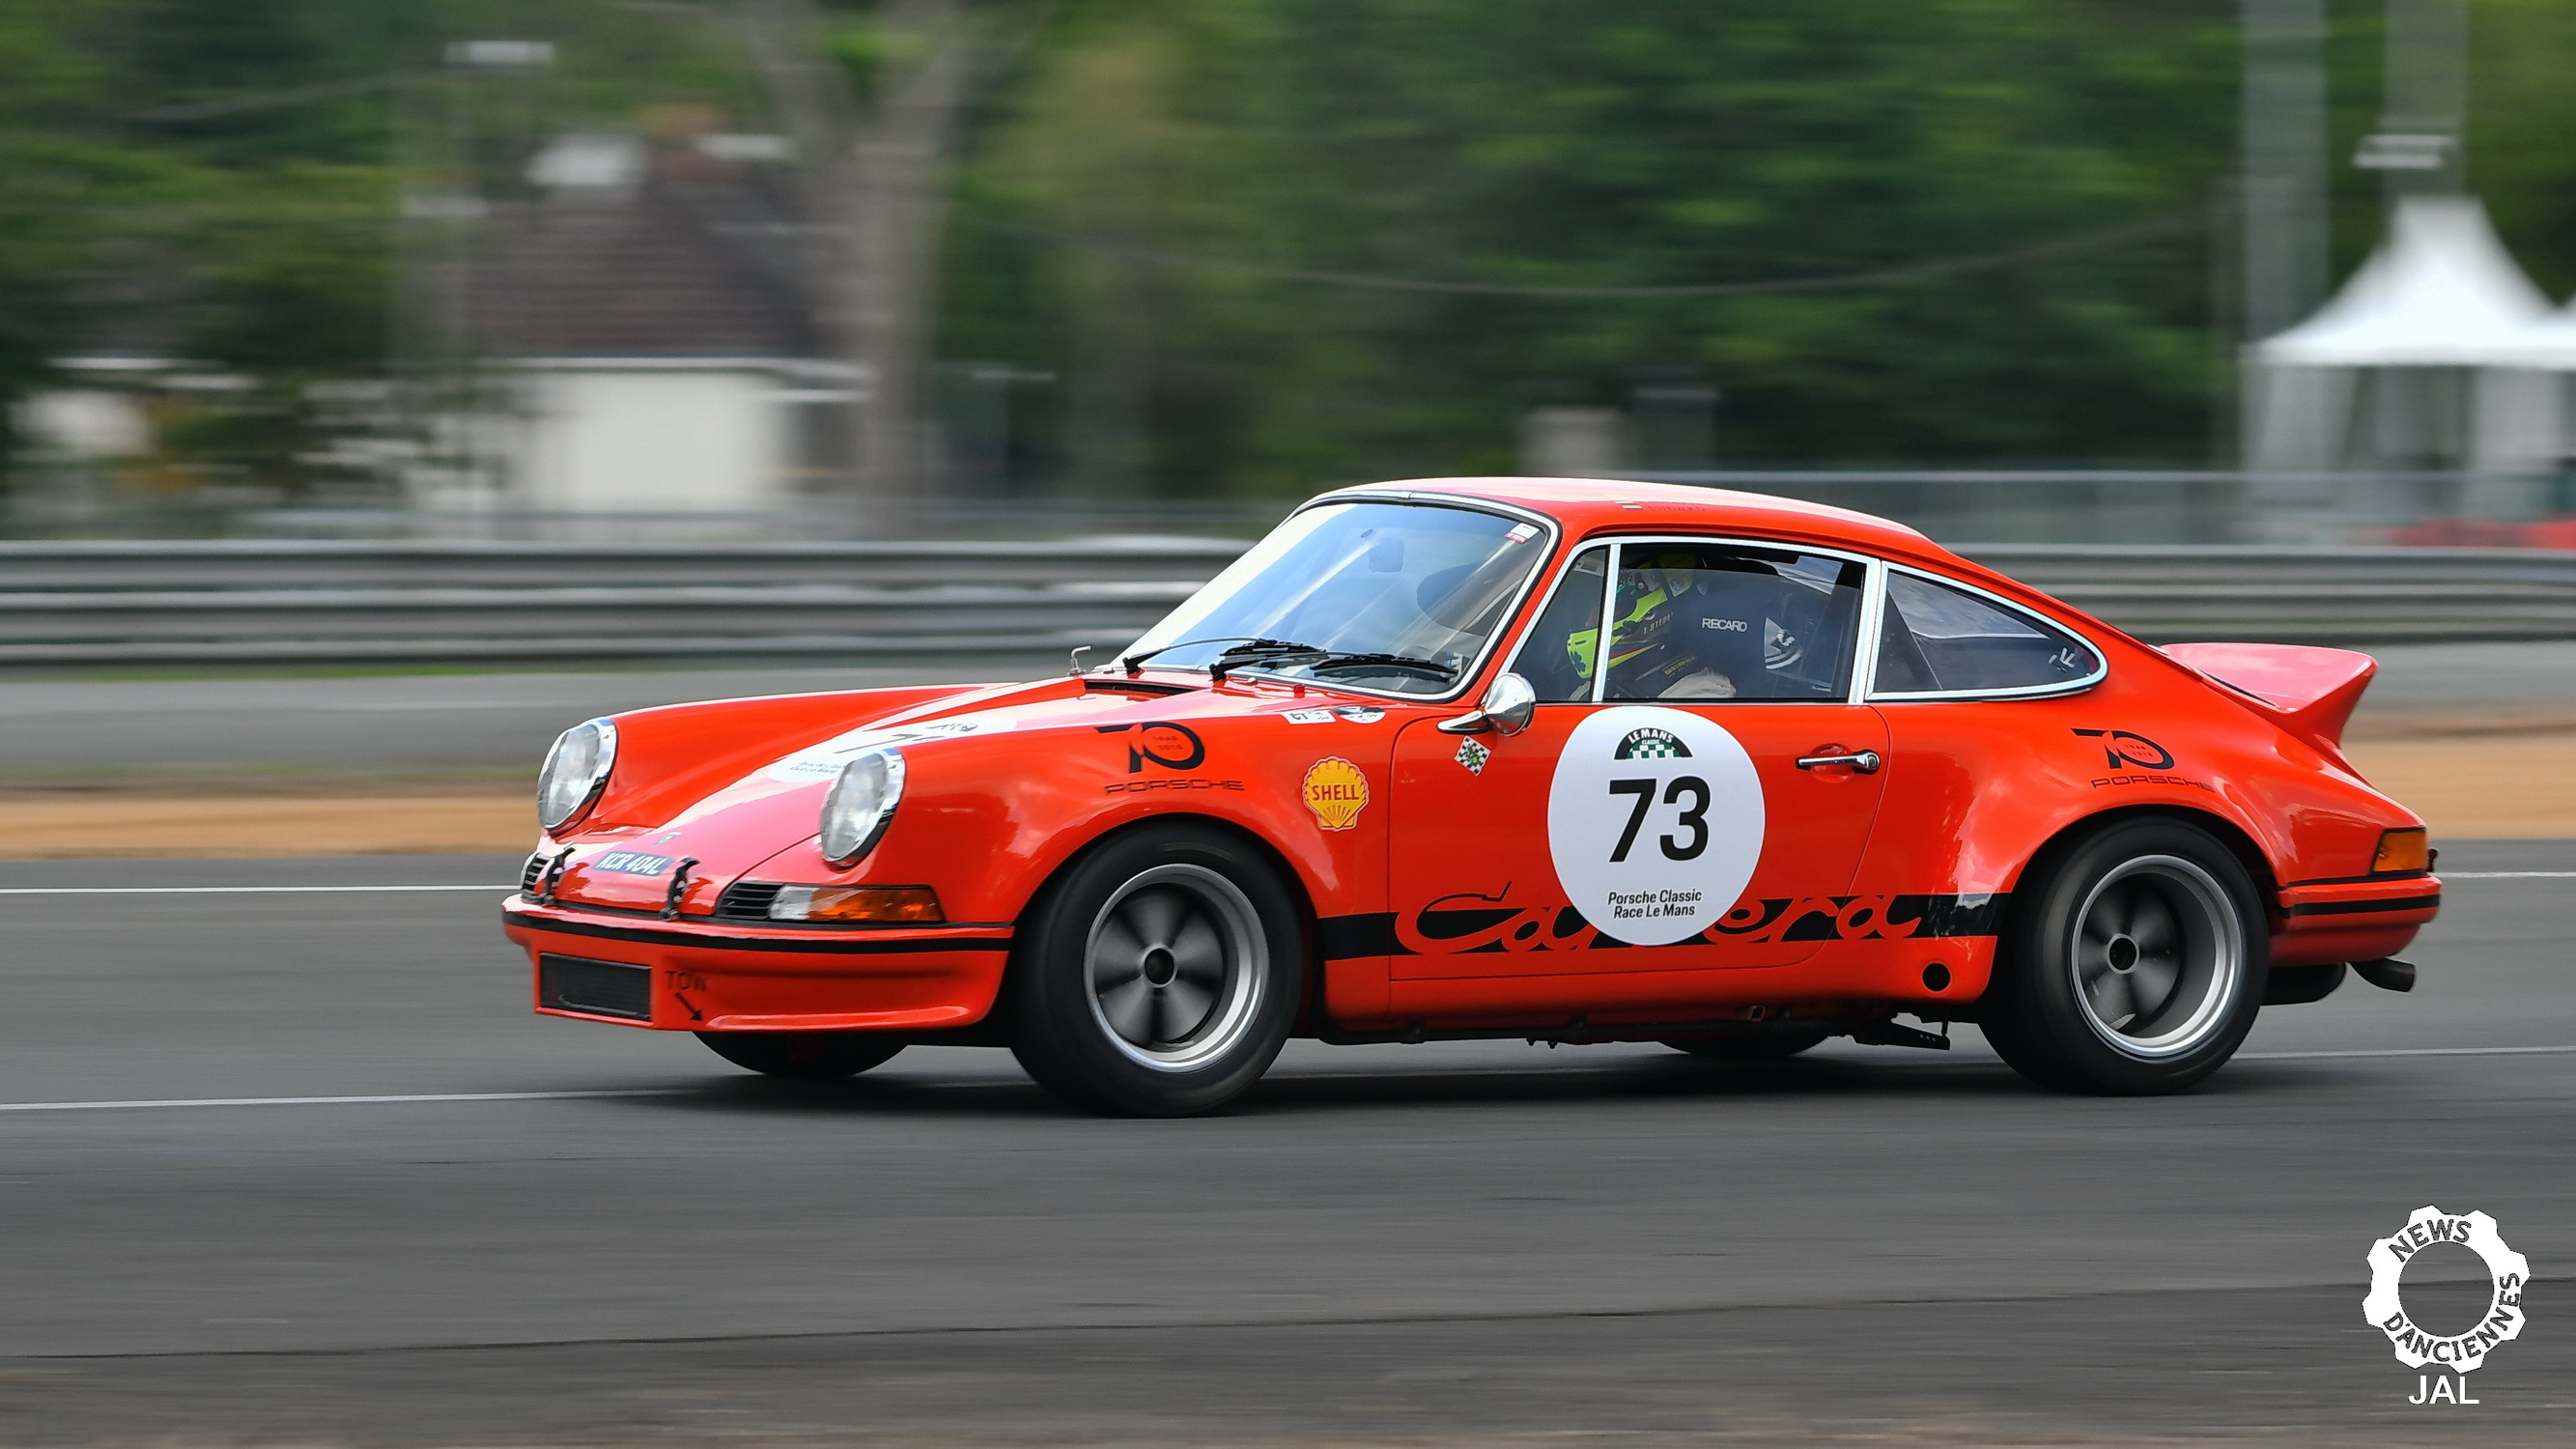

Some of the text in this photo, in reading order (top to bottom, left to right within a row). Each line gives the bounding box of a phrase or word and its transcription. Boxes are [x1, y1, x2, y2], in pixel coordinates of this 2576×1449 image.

[1702, 617, 1748, 633] RECARO
[1104, 779, 1245, 795] PORSCHE
[1312, 784, 1360, 801] SHELL
[2090, 775, 2217, 793] PORSCHE
[1608, 776, 1712, 863] 73
[1607, 888, 1703, 905] Porsche Classic
[1395, 880, 1922, 954] Caera
[1613, 903, 1696, 919] Race Le Mans
